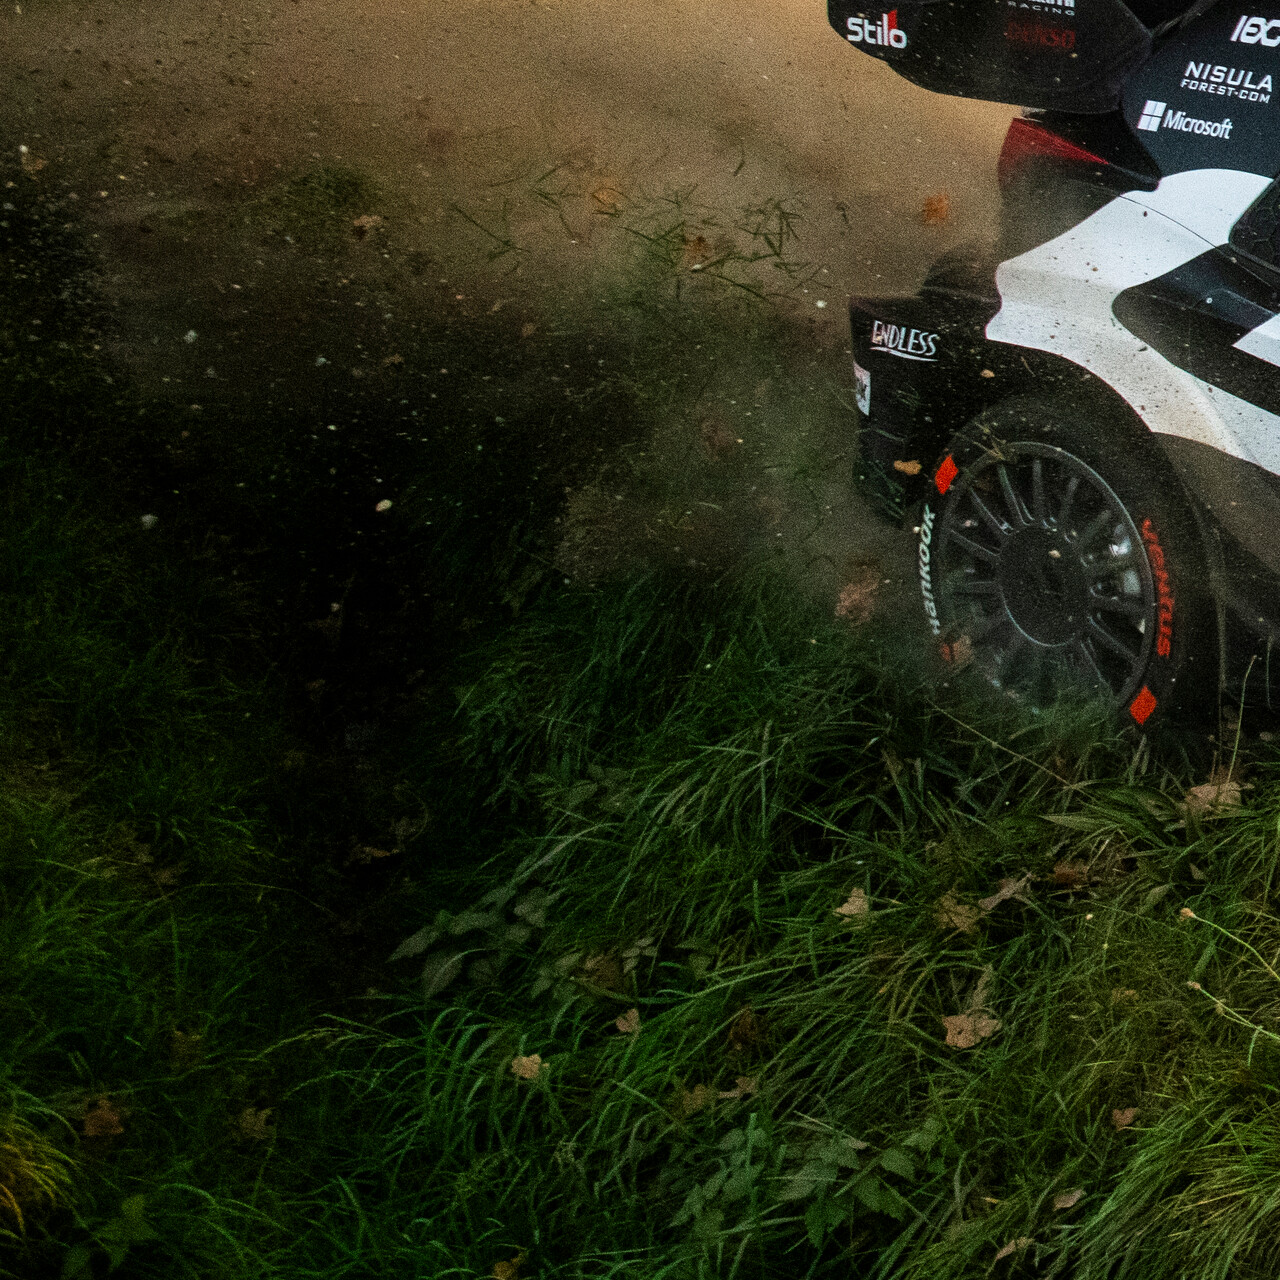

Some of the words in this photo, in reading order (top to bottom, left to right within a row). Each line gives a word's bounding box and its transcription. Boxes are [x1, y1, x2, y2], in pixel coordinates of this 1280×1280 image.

[1008, 1, 1075, 16] RACING
[846, 10, 908, 49] Stilo
[1184, 61, 1273, 92] NISULA
[1162, 110, 1233, 140] Microsoft
[871, 320, 938, 356] ENDLESS
